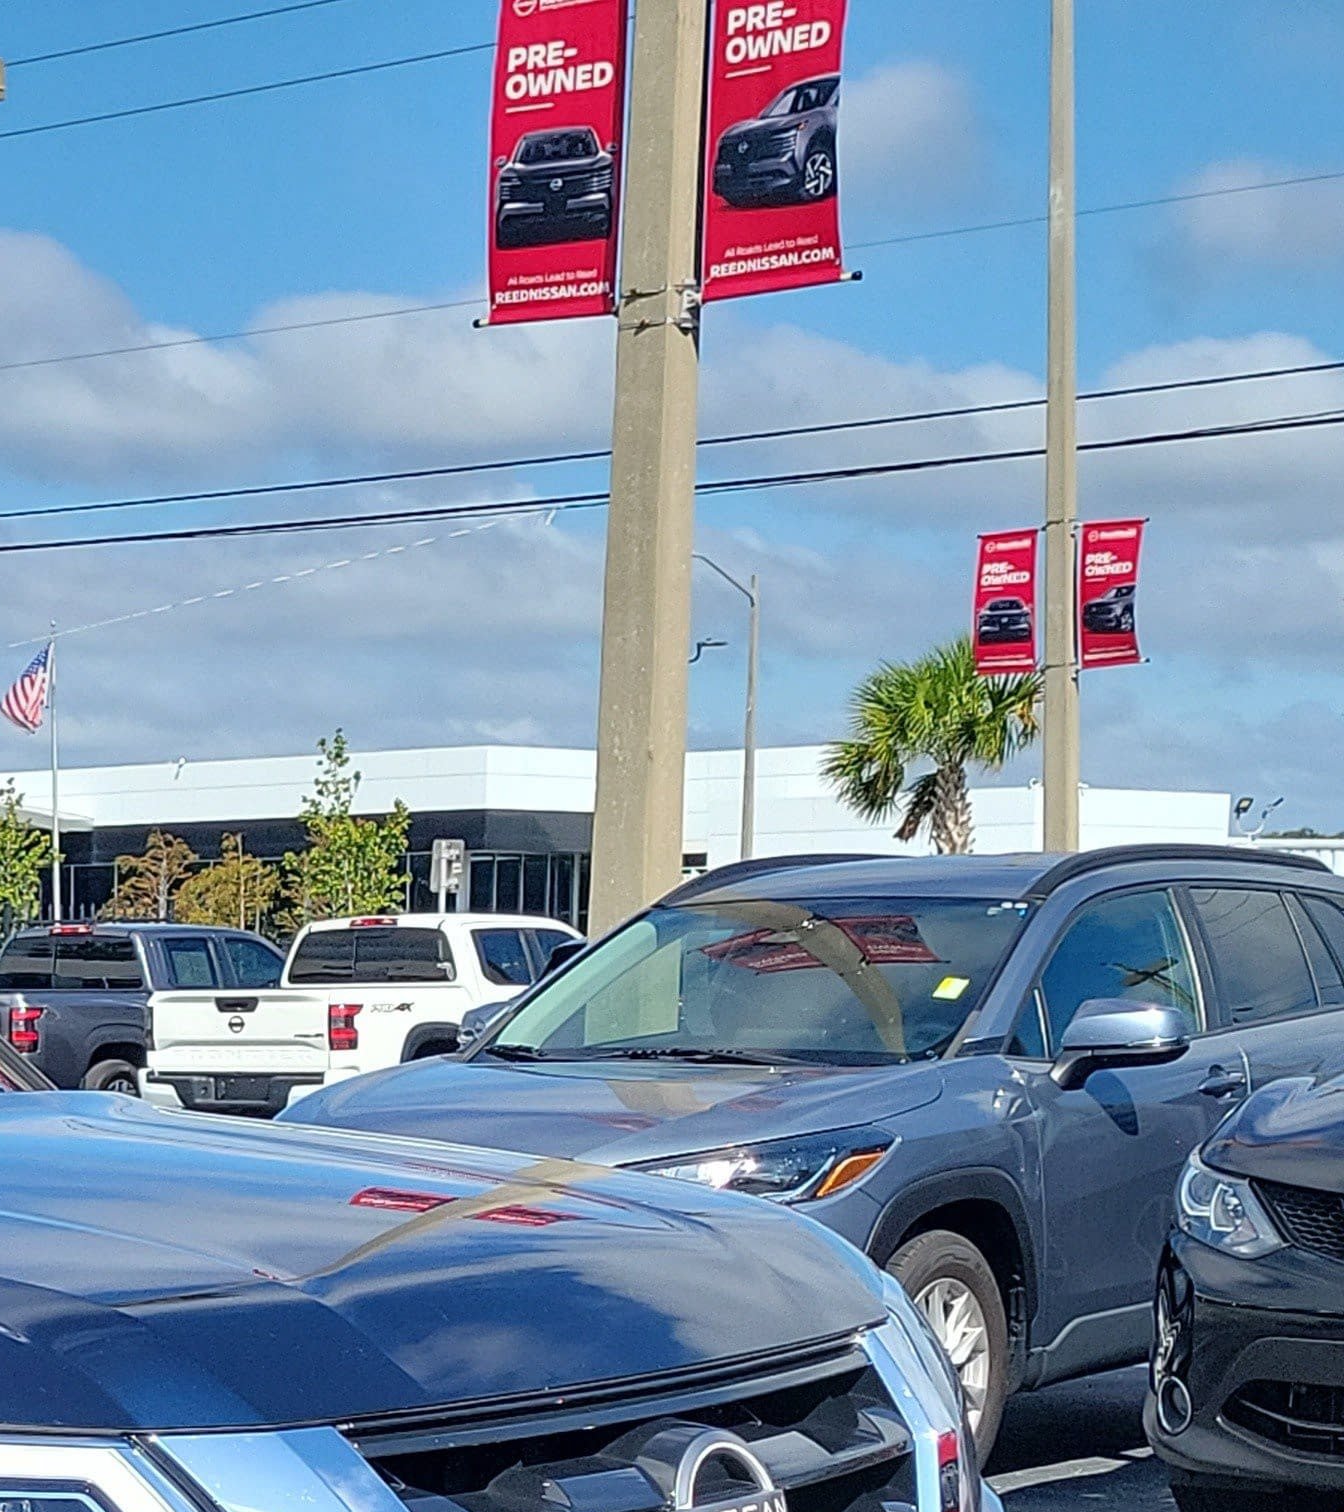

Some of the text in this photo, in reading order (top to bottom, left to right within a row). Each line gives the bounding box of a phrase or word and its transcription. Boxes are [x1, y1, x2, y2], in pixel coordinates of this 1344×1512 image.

[727, 0, 797, 36] PRE-
[507, 40, 578, 73] PRE-
[725, 20, 831, 64] OWNED
[505, 61, 614, 100] OWNED
[710, 246, 835, 278] REEDNISSAN.COM
[495, 281, 610, 304] REEDNISSAN.COM
[980, 571, 1030, 586] OWNED
[1084, 561, 1133, 576] OWNED
